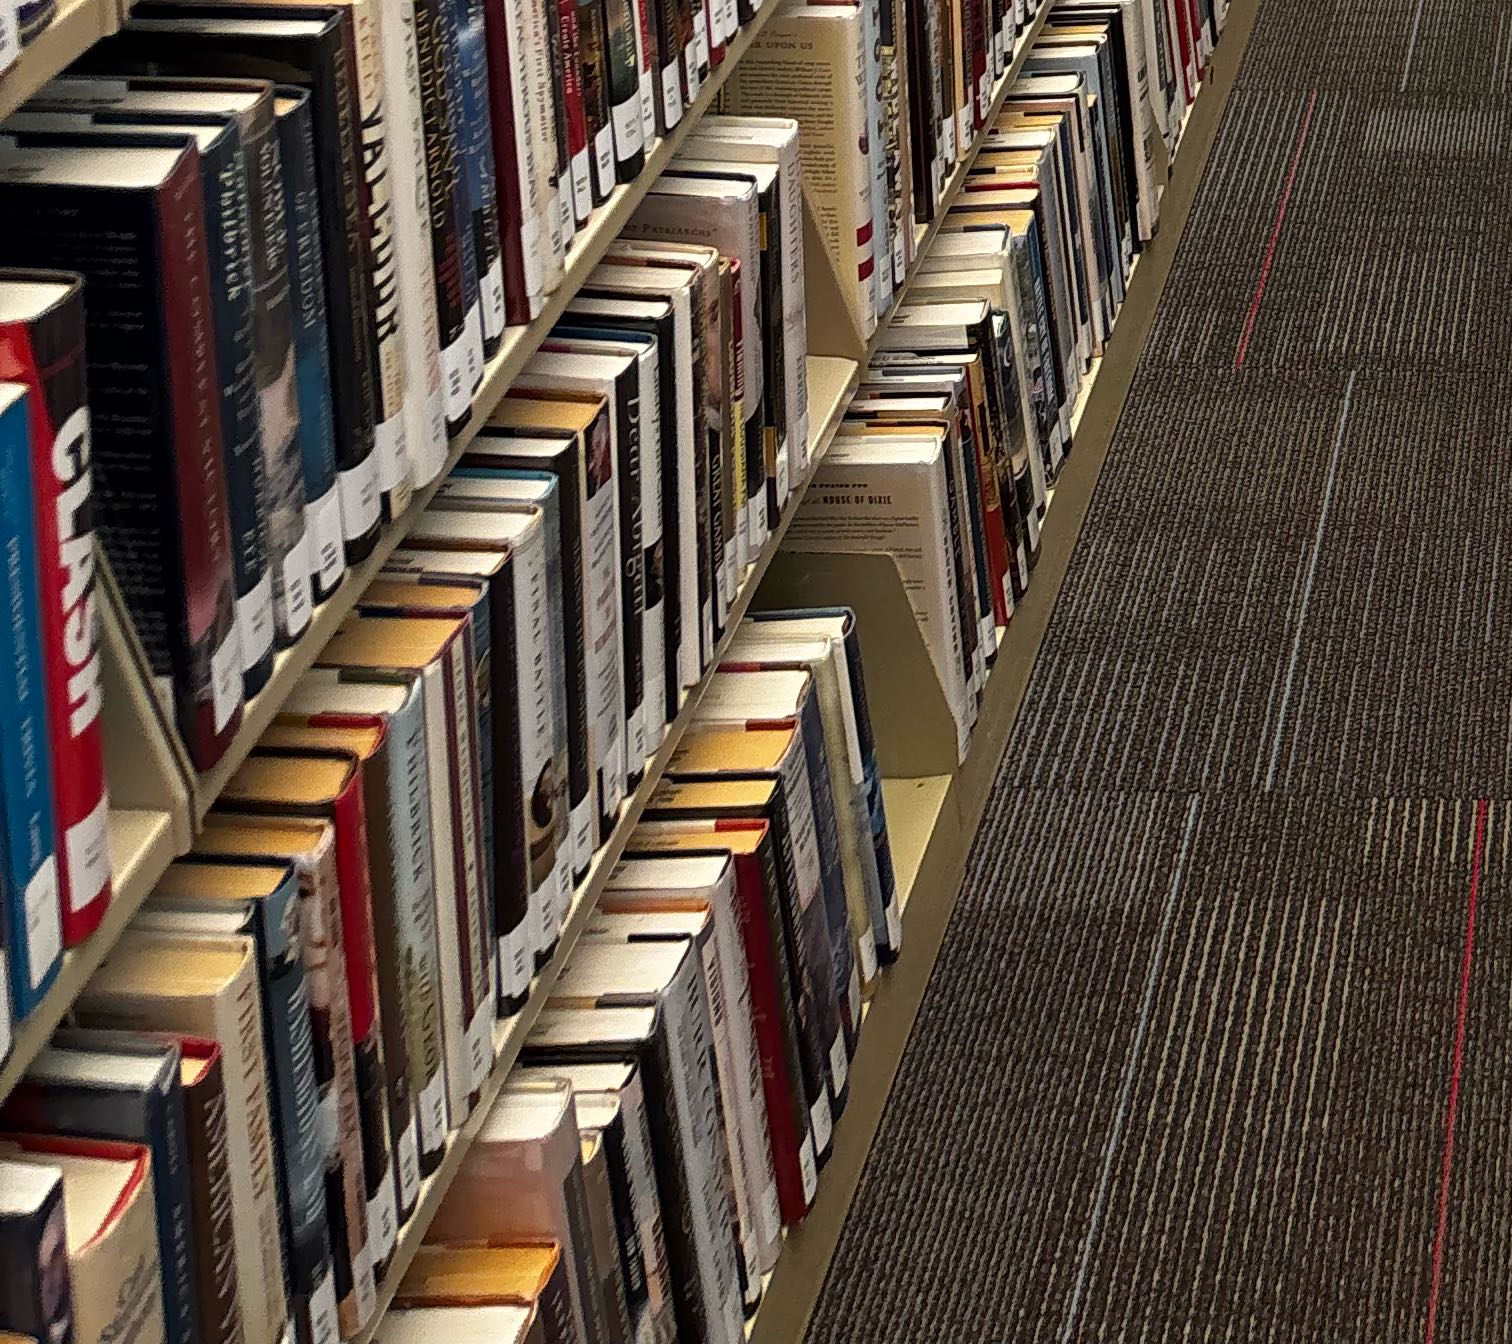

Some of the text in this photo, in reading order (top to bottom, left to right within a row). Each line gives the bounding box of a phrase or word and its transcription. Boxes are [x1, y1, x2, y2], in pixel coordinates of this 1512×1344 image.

[562, 52, 573, 95] America
[625, 397, 644, 478] Dear
[51, 405, 100, 737] CLASH
